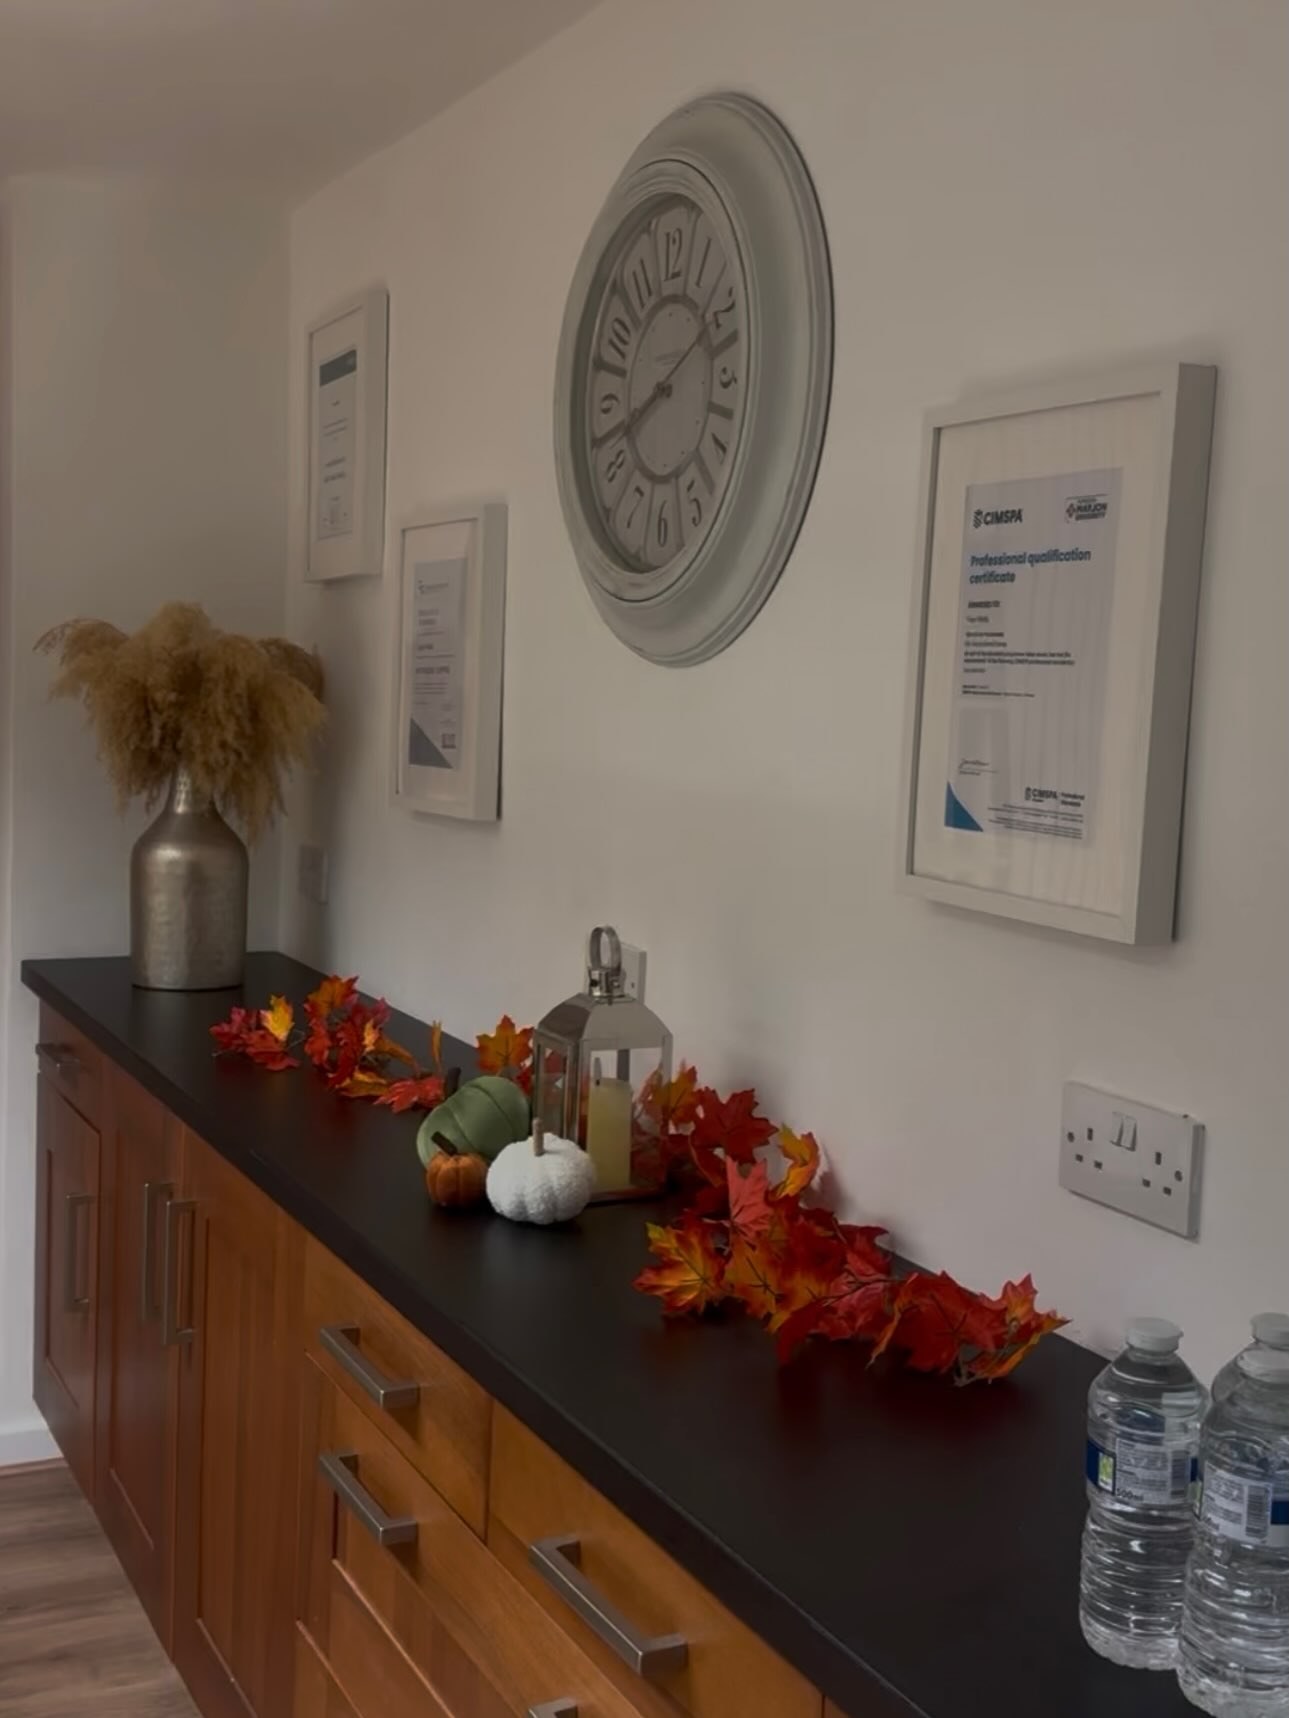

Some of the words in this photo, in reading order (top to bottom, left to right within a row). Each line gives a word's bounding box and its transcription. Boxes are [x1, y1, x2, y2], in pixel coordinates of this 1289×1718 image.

[663, 228, 683, 282] 12
[695, 236, 712, 288] 1
[632, 258, 653, 309] 11
[713, 286, 736, 329] 2
[608, 316, 631, 359] 10
[720, 366, 737, 389] 3
[600, 393, 620, 415] 9
[606, 449, 625, 483] 8
[626, 485, 644, 529] 7
[657, 499, 668, 548] 6
[686, 479, 702, 527] 5
[983, 508, 1023, 526] CIMSPA
[969, 571, 1016, 584] certificate
[970, 552, 1027, 567] Professional
[1027, 547, 1092, 568] qualification
